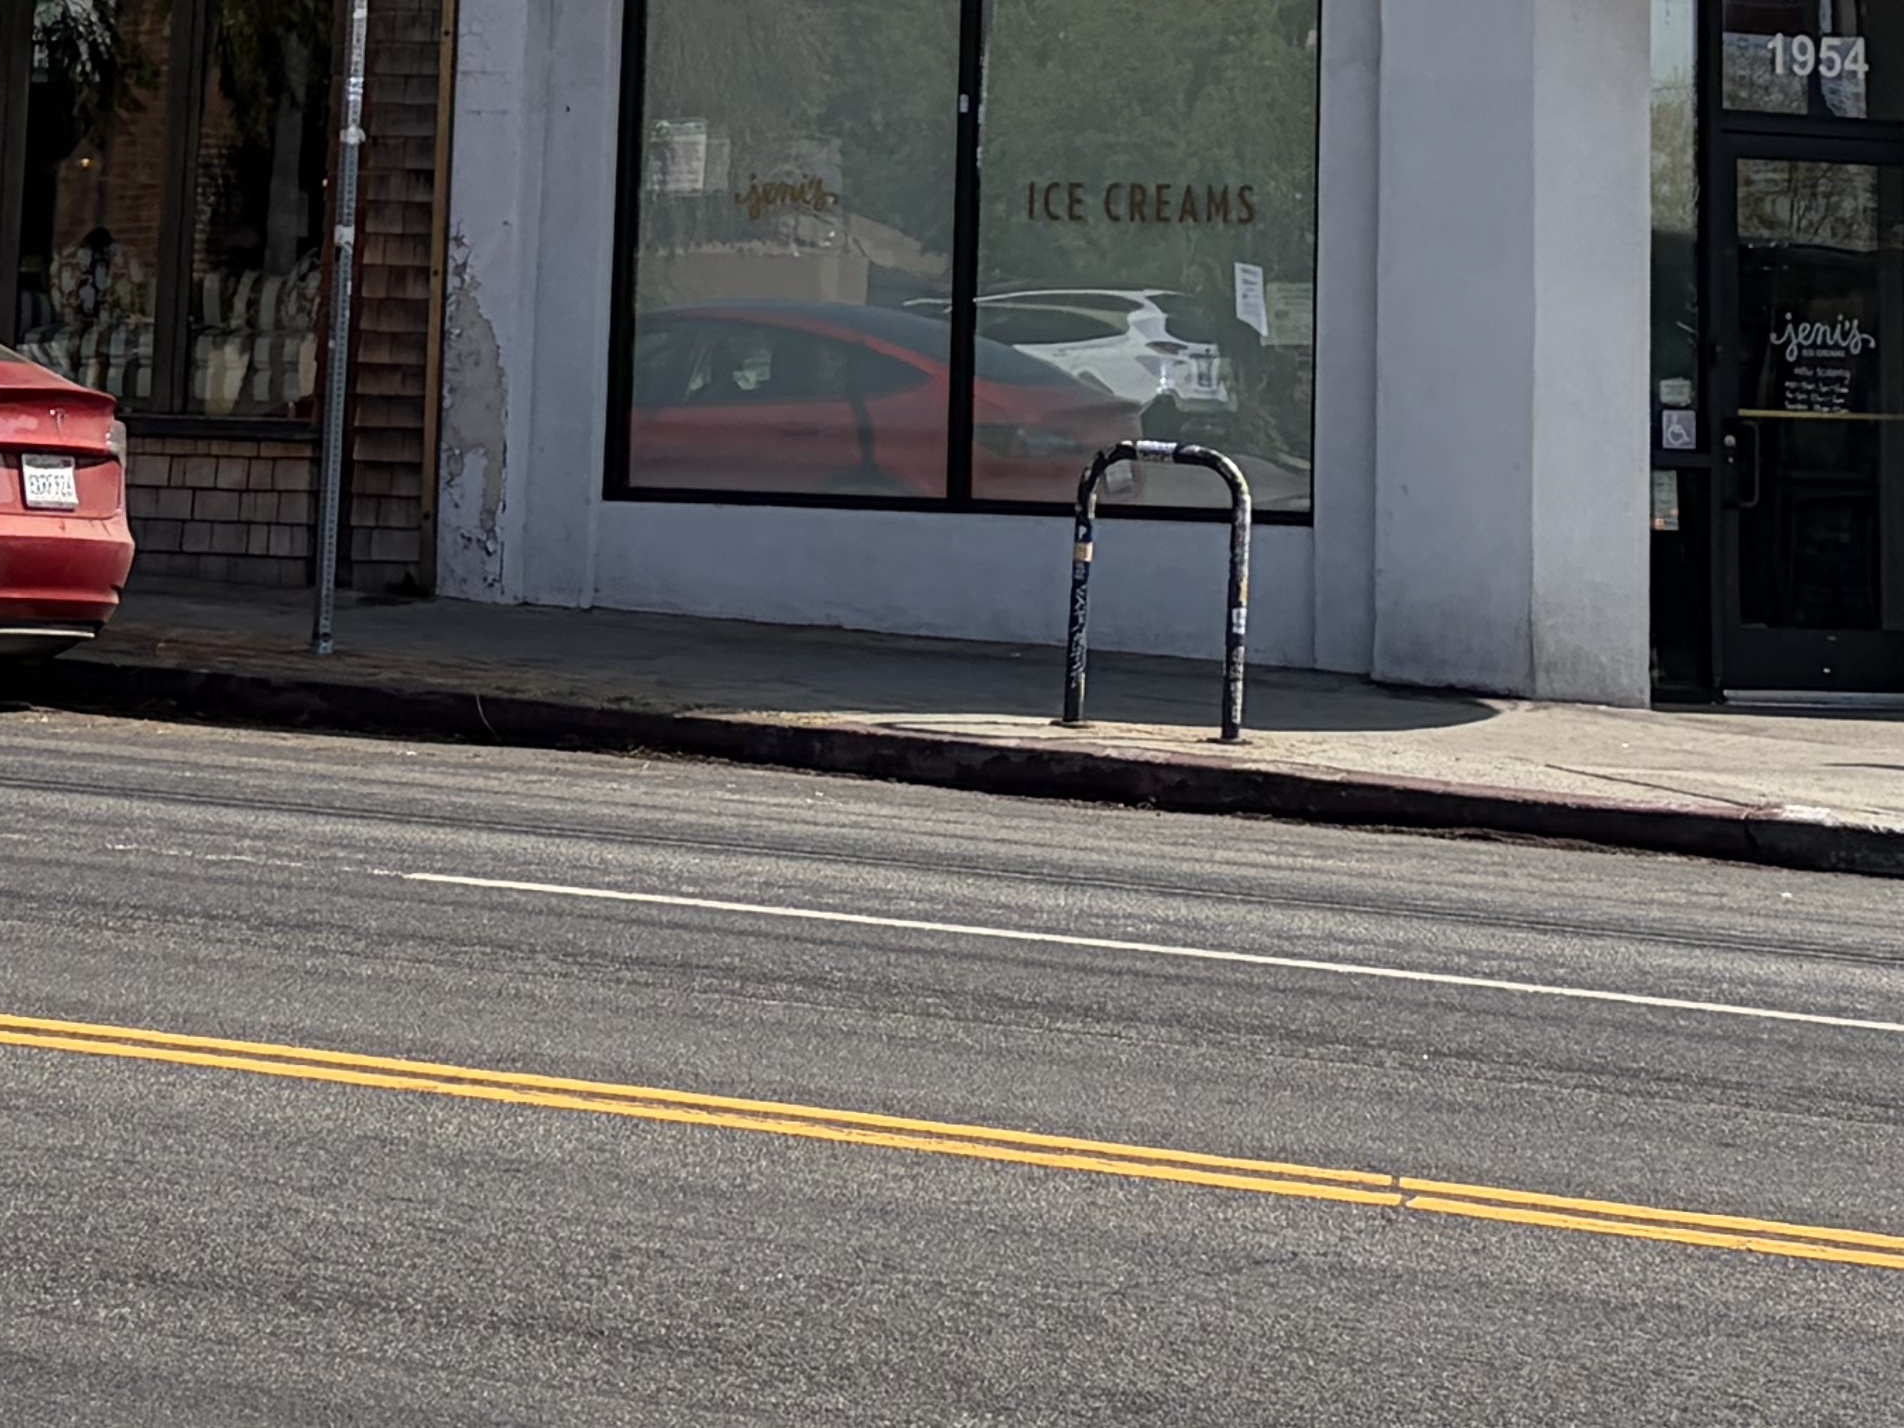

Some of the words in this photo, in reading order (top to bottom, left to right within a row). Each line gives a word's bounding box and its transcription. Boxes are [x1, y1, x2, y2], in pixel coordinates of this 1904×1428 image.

[1767, 32, 1869, 80] 1954
[1028, 181, 1084, 222] ICE
[1103, 183, 1256, 225] CREAMS
[1770, 311, 1876, 363] jeni's
